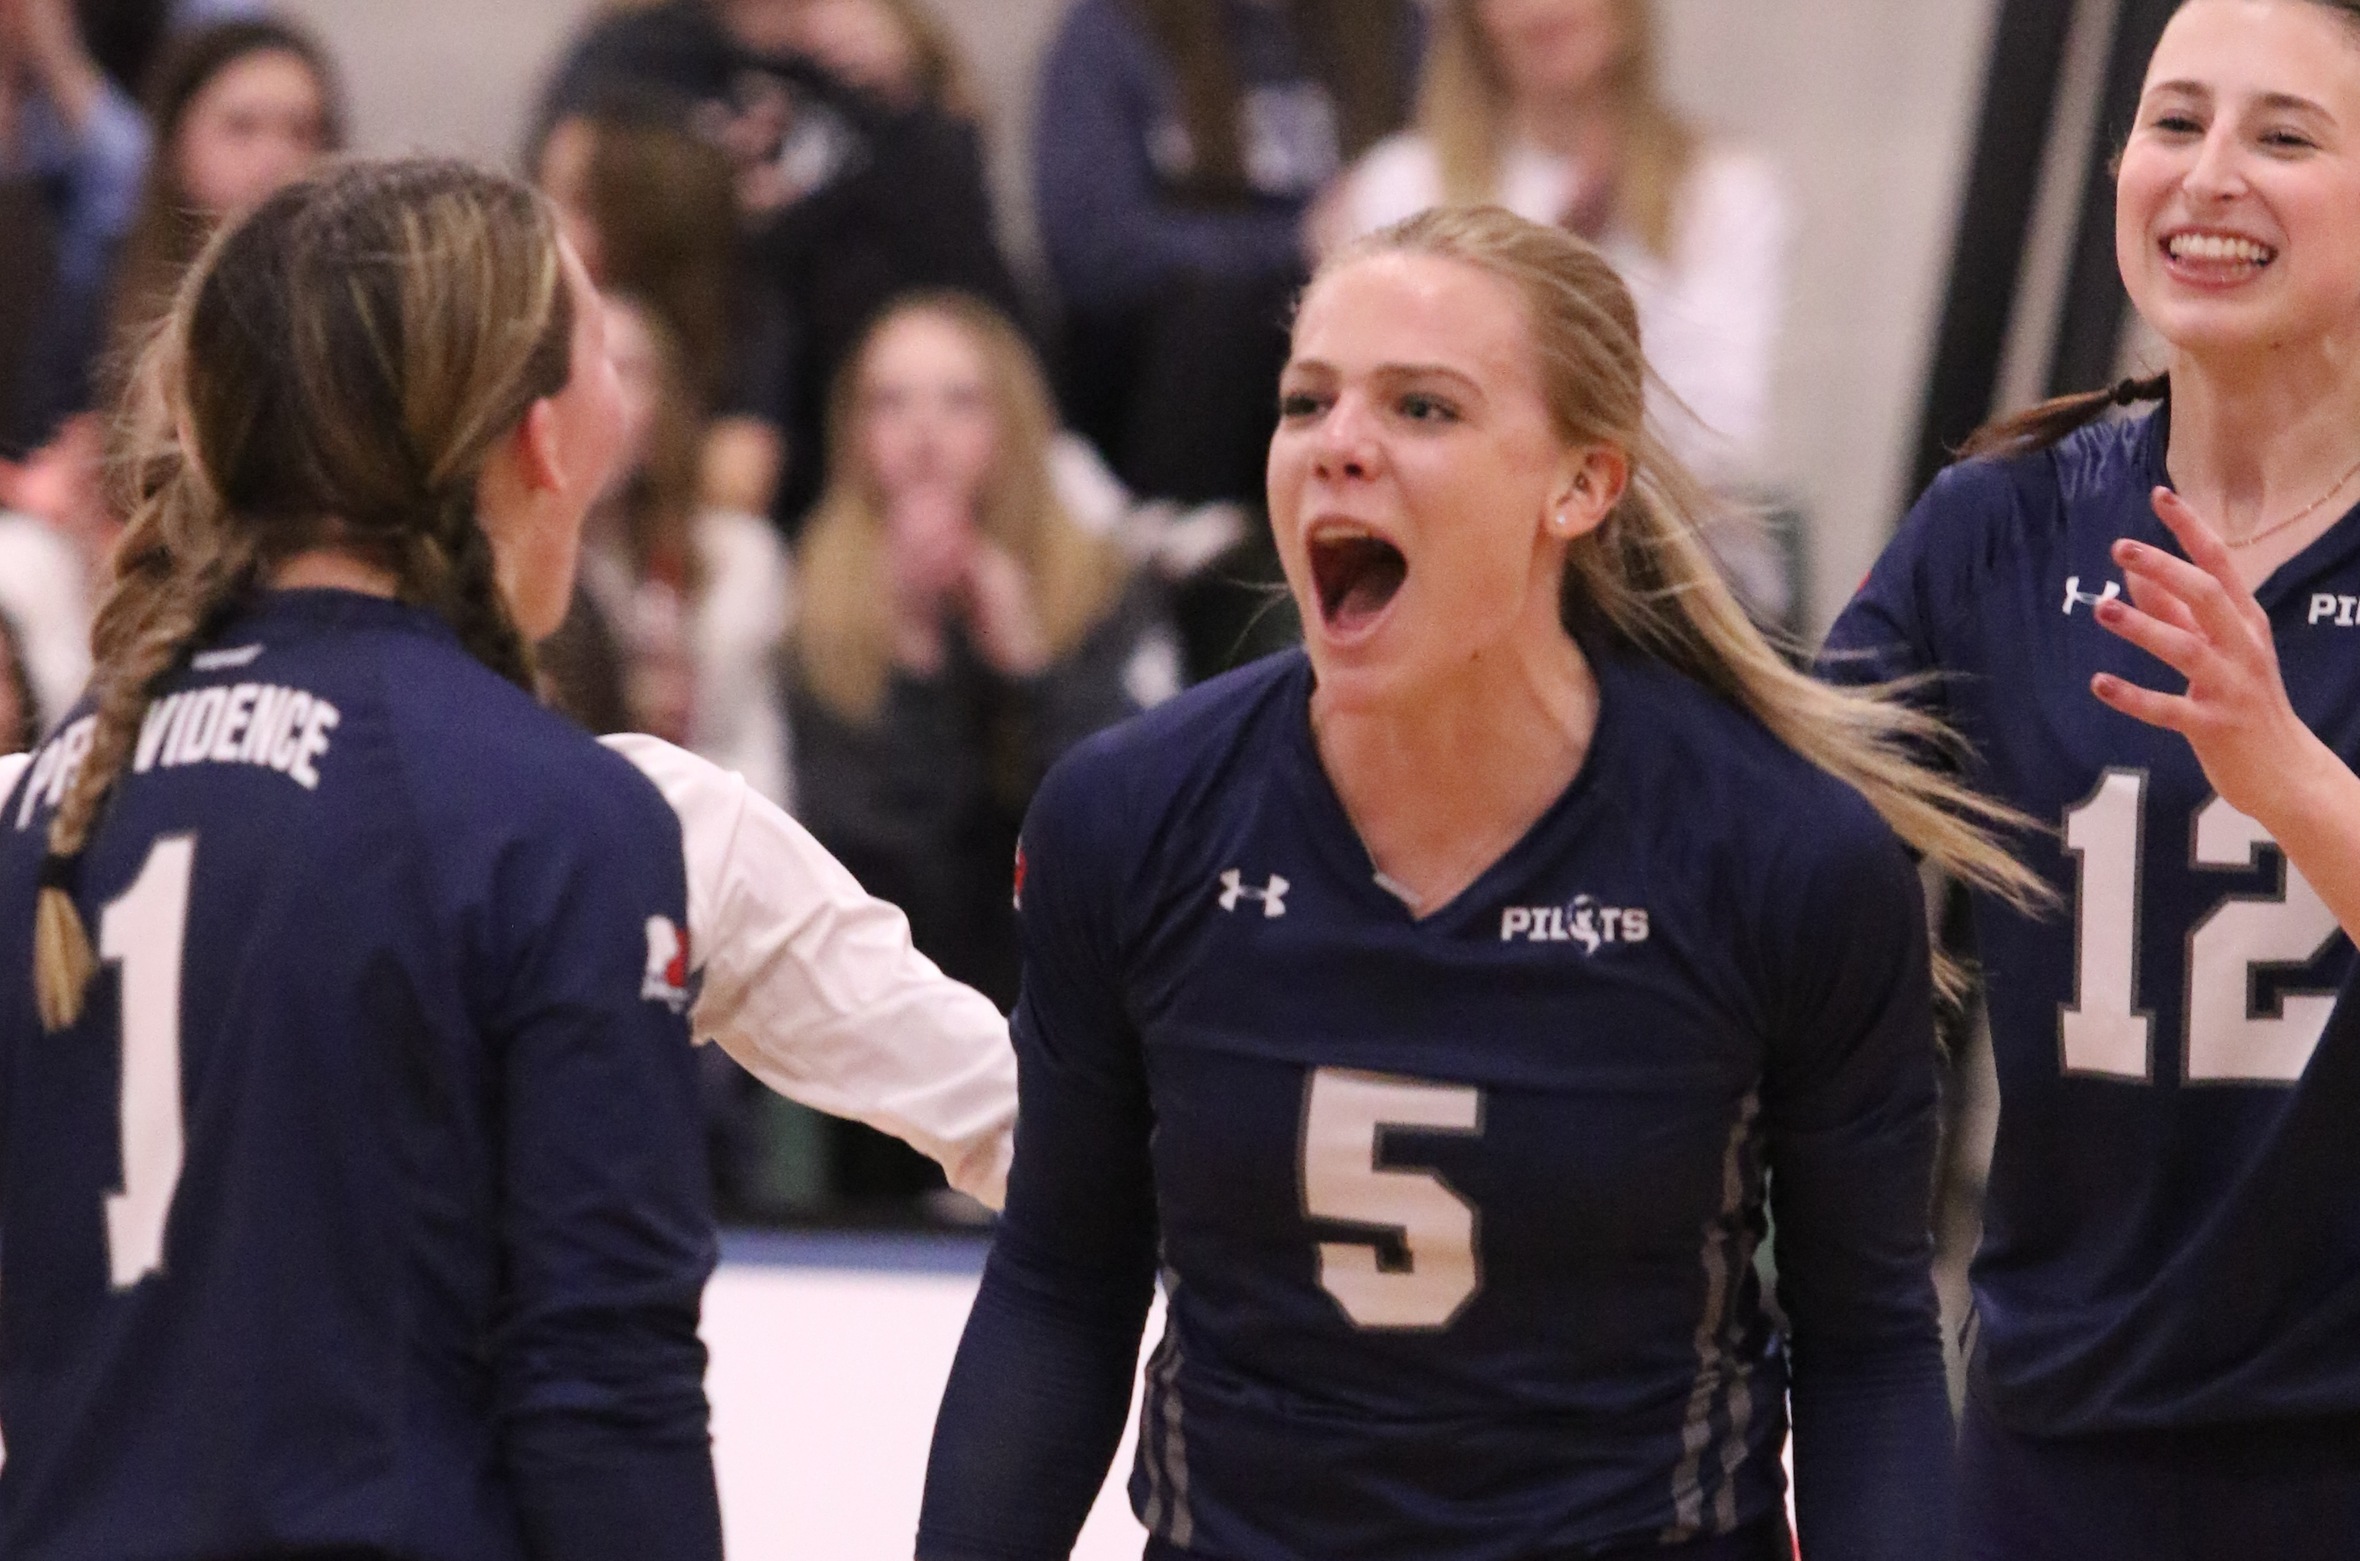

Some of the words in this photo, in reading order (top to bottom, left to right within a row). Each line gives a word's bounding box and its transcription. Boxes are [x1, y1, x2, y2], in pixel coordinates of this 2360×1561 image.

[14, 682, 341, 831] PRVIDENCE
[97, 833, 197, 1290] 1
[2057, 768, 2340, 1086] 12
[1301, 1064, 1484, 1335] 5
